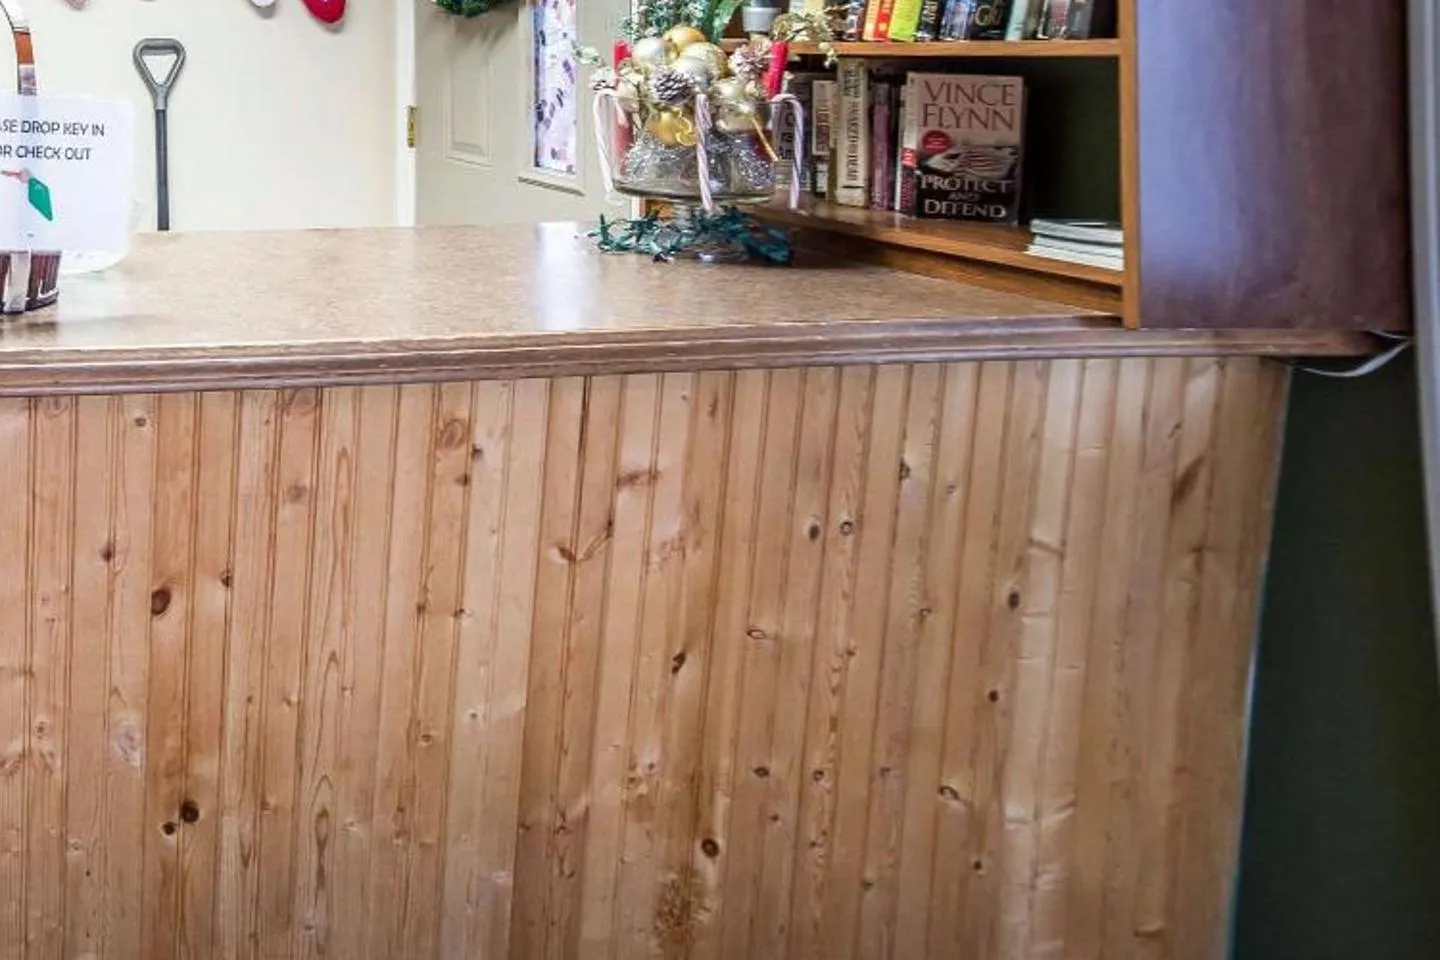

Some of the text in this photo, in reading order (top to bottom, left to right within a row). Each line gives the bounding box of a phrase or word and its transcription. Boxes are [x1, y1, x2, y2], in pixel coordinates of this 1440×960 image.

[924, 78, 1015, 106] VINCE
[922, 103, 1014, 131] FLYNN
[21, 120, 60, 134] DROP
[63, 122, 89, 136] KEY
[91, 124, 105, 137] IN
[16, 145, 60, 159] CHECK
[64, 147, 92, 160] OUT
[919, 174, 1010, 193] PROTECT
[924, 199, 1008, 218] DEFEND
